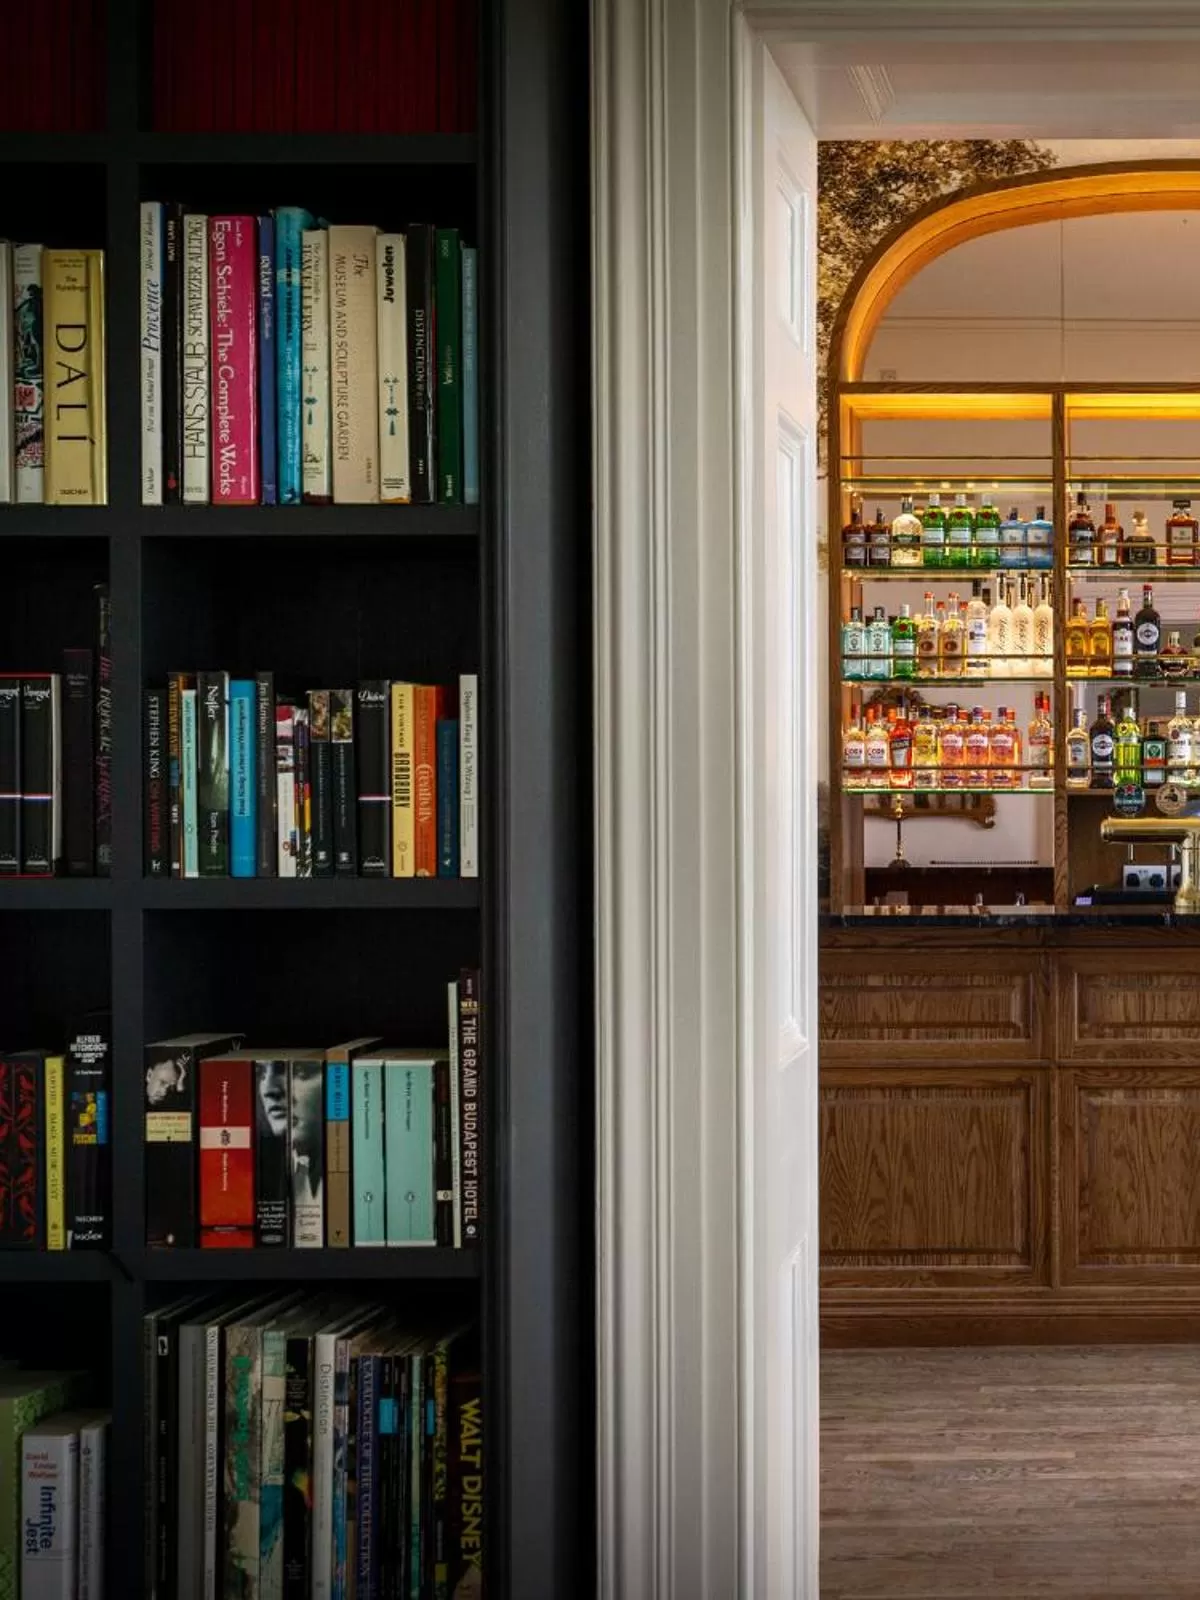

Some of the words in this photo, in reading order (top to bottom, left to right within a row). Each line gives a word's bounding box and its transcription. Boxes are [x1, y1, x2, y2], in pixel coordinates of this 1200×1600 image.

[185, 220, 204, 263] ALLTAG
[213, 220, 232, 261] Egon
[215, 264, 234, 328] Schiele:
[335, 254, 348, 308] MUSEUM
[382, 245, 395, 304] Juwelen
[141, 279, 160, 352] Provence
[185, 266, 204, 338] SCHWEIZER
[335, 311, 348, 340] AND
[183, 341, 207, 401] STAUB
[217, 330, 234, 361] The
[56, 324, 96, 447] DALÍ
[336, 341, 349, 409] SCULPTURE
[214, 365, 237, 443] Complete
[183, 403, 206, 460] HANS
[336, 411, 350, 461] GARDEN
[218, 443, 238, 496] Works
[148, 695, 160, 747] STEPHEN
[463, 690, 475, 722] Stephen
[463, 723, 475, 742] King
[148, 750, 160, 780] KING
[394, 753, 411, 809] BRADBURY
[463, 766, 475, 796] Writing
[464, 750, 475, 765] On
[415, 763, 435, 824] Creativity
[150, 800, 161, 853] WRITING
[463, 1017, 477, 1045] THE
[463, 1049, 477, 1097] GRAND
[463, 1102, 478, 1177] BUDAPEST
[463, 1180, 478, 1224] HOTEL
[319, 1363, 332, 1435] Distinction
[360, 1360, 374, 1439] CATALOGUE
[360, 1443, 373, 1461] OF
[459, 1398, 483, 1470] WALT
[360, 1465, 373, 1491] THE
[25, 1518, 40, 1555] Jest
[39, 1485, 57, 1550] Infinite
[359, 1494, 373, 1578] COLLECTION
[459, 1474, 483, 1565] DISNEY
